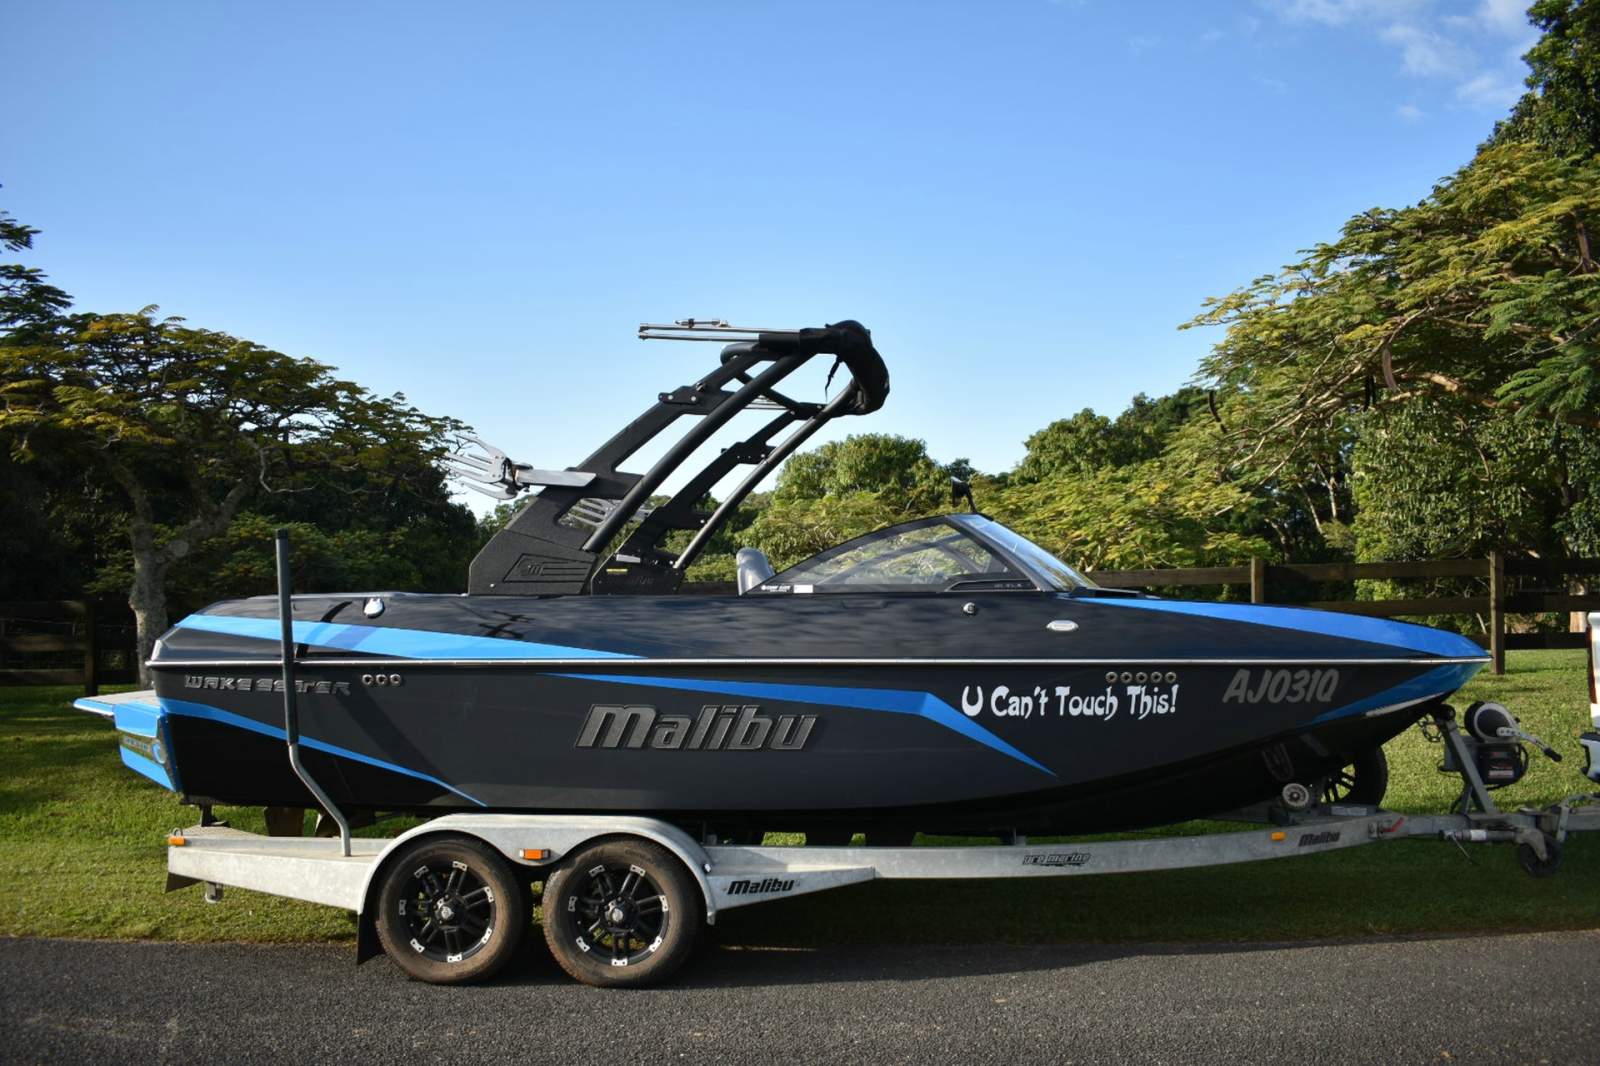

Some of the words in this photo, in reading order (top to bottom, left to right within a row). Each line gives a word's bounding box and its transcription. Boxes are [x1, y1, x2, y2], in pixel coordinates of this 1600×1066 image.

[962, 686, 984, 717] U
[991, 685, 1048, 719] Can't
[1055, 686, 1118, 721] Touch
[1126, 684, 1179, 720] This!
[575, 703, 818, 750] Malibu
[727, 878, 795, 895] Malibu
